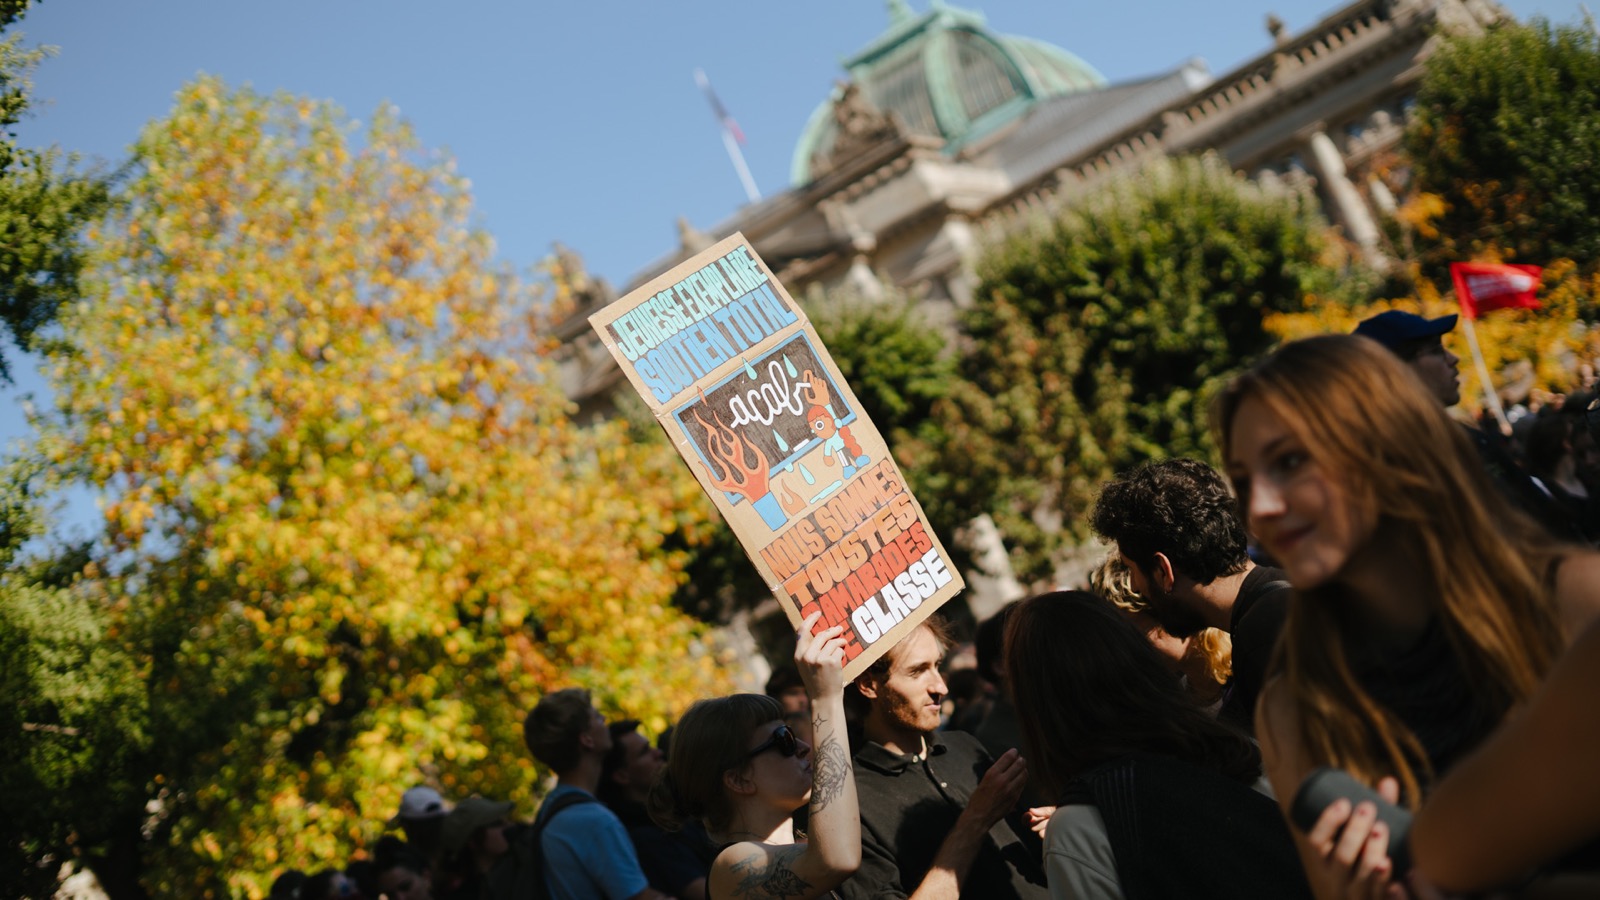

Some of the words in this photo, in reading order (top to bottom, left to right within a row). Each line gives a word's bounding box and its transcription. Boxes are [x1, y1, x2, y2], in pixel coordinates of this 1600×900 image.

[612, 290, 695, 361] JEUNESSE
[712, 283, 799, 351] TOTAL
[729, 360, 811, 429] acab
[760, 518, 826, 582] NOUS
[814, 458, 903, 543] SOMMES
[783, 491, 918, 606] TOUSTES
[851, 547, 953, 644] CLASSE
